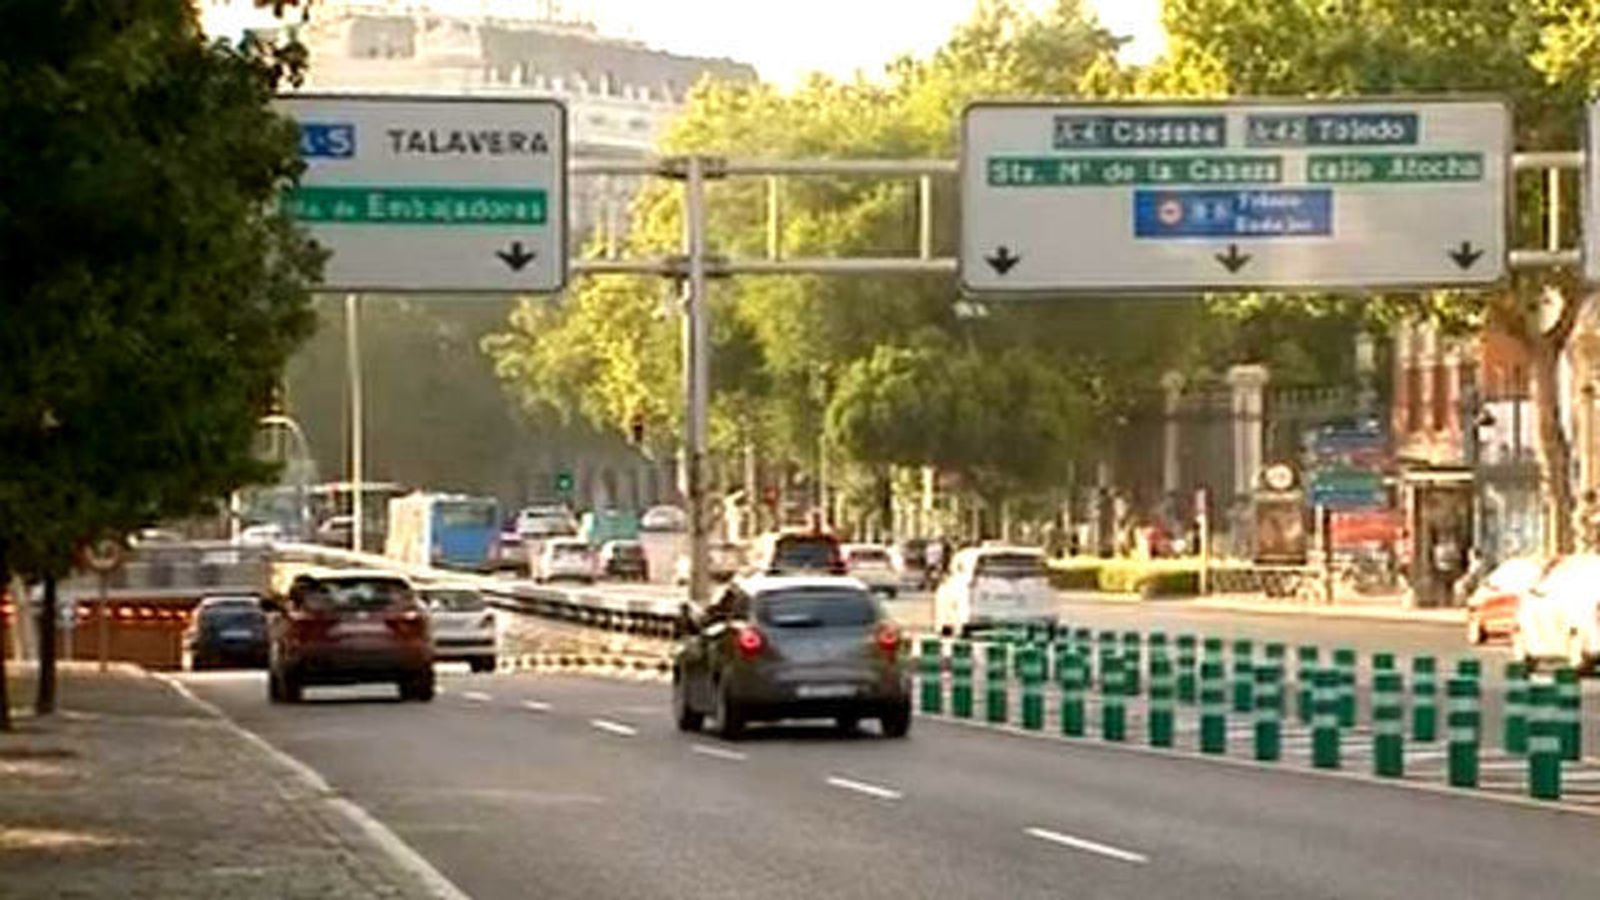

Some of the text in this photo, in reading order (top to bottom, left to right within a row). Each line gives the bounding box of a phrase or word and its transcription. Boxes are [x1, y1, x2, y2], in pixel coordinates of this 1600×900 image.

[387, 129, 548, 155] TALAVERA
[1318, 118, 1405, 141] Toledo
[367, 193, 542, 221] Embajadores
